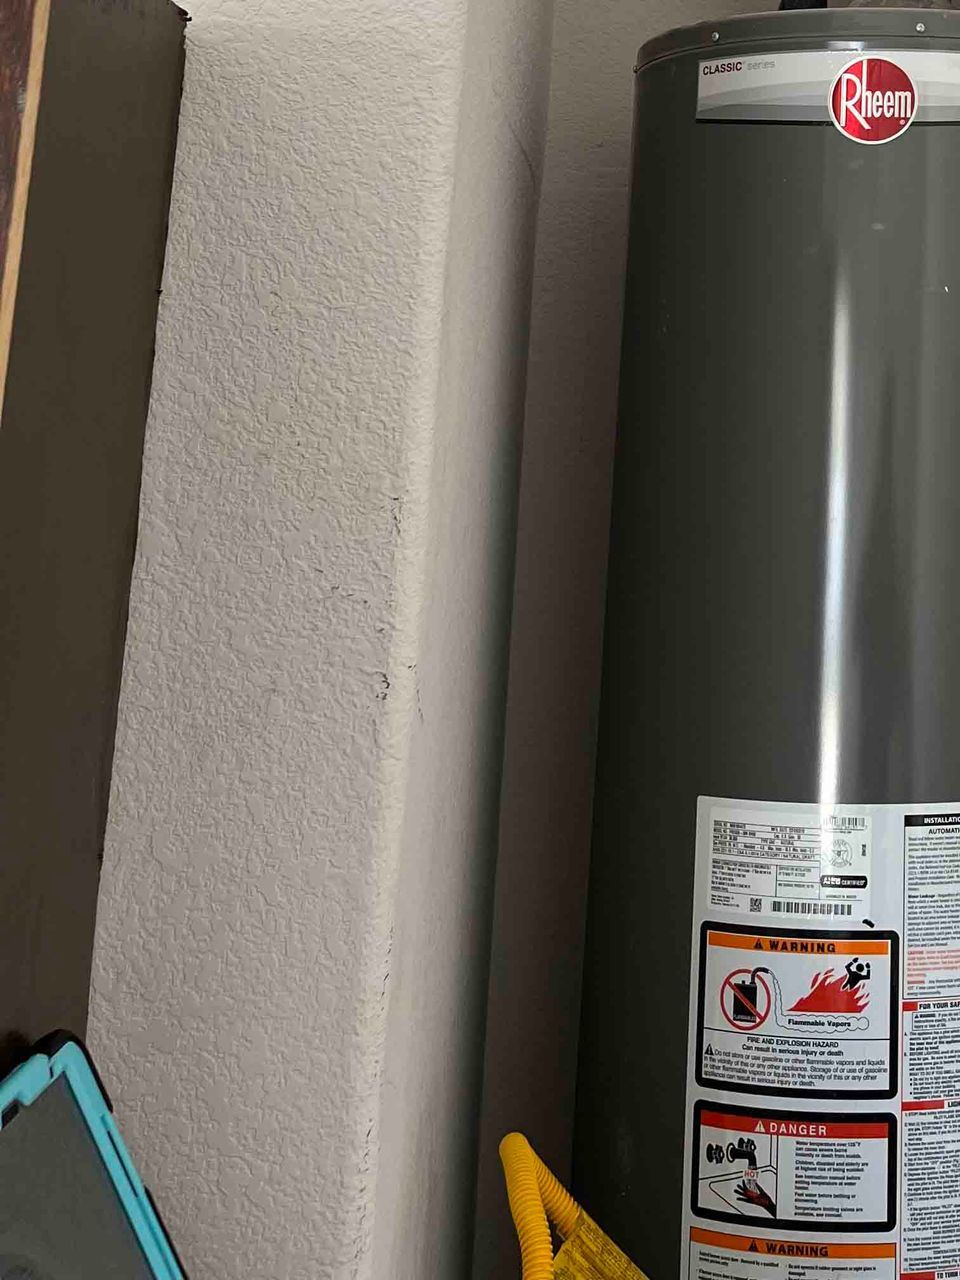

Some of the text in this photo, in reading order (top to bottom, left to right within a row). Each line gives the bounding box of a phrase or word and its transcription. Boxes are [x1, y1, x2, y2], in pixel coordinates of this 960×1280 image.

[703, 61, 775, 75] CLASSIC series
[840, 60, 912, 130] Rheem
[769, 940, 836, 952] WARNING
[788, 1018, 826, 1026] Flammable
[776, 1038, 810, 1047] EXPLOSION
[770, 1122, 827, 1136] DANGER
[744, 1170, 760, 1180] HOT
[766, 1242, 828, 1257] WARNING
